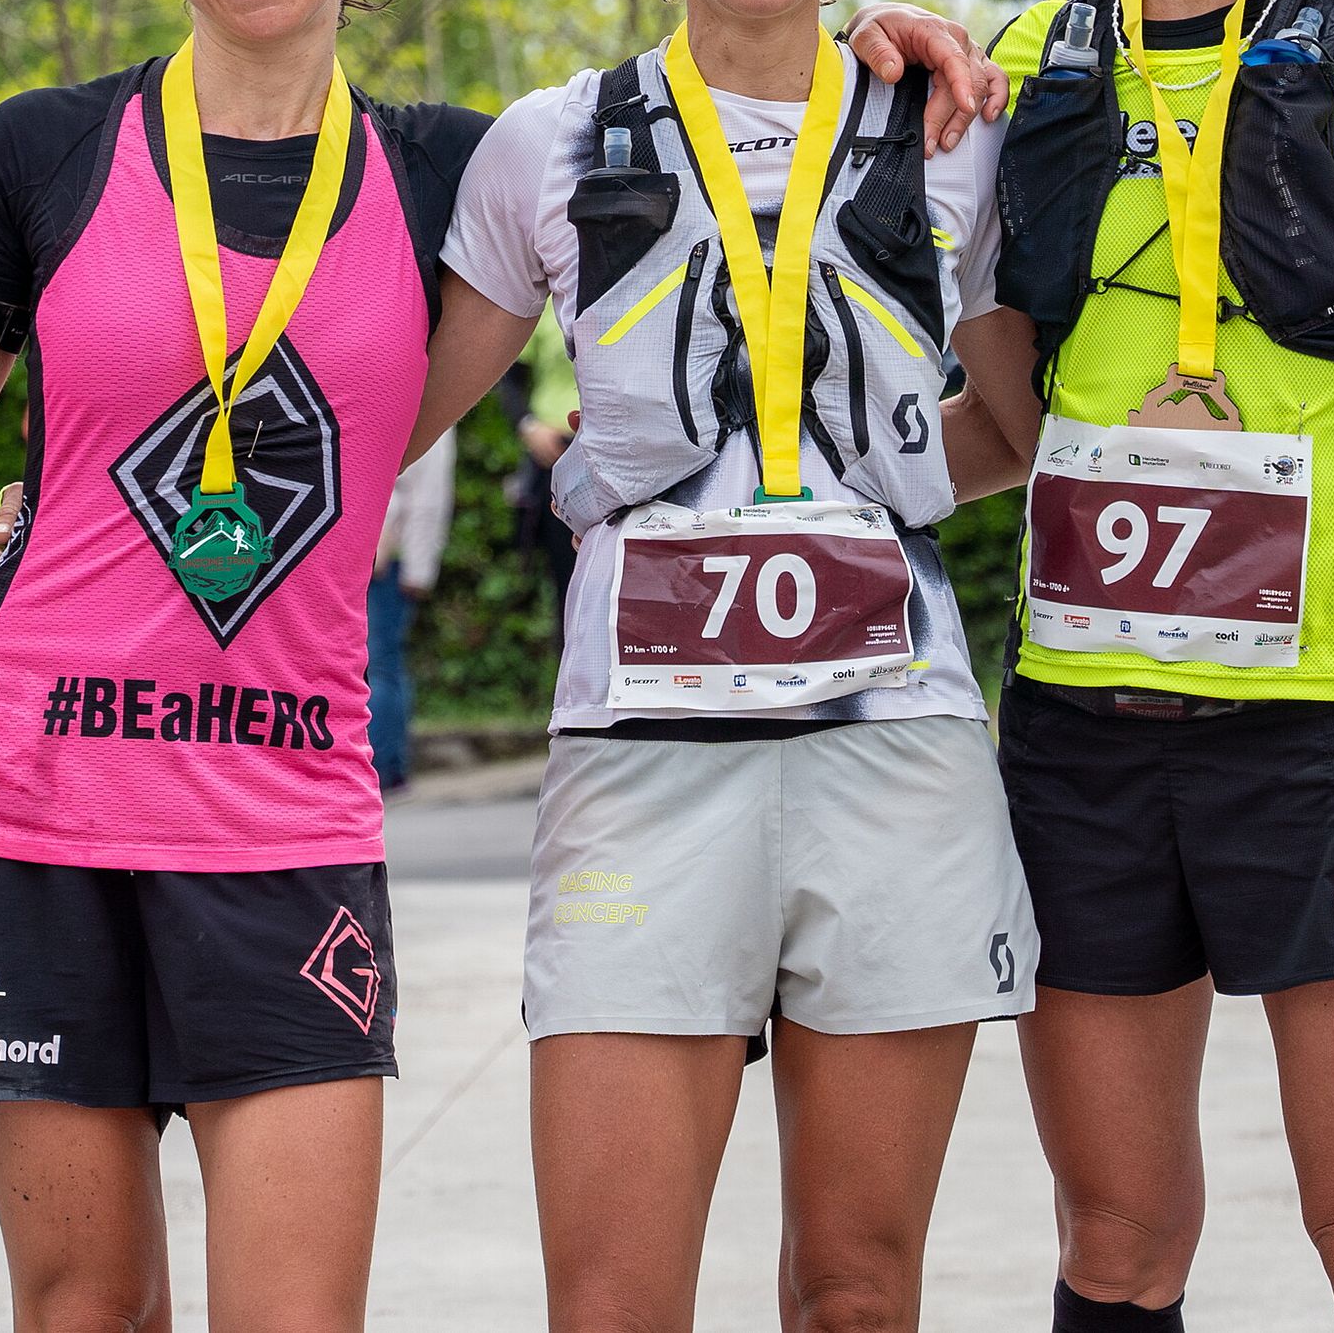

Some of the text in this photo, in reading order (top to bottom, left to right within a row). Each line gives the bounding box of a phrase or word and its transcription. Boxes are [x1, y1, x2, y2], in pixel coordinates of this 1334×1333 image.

[1095, 500, 1213, 589] 97
[701, 553, 817, 639] 70
[1157, 630, 1189, 640] Moreschi
[1215, 629, 1239, 641] corti
[624, 645, 634, 654] 29
[634, 645, 646, 653] km
[650, 645, 668, 654] 1700
[832, 667, 855, 679] corti
[775, 678, 808, 687] Moreschi
[43, 676, 335, 752] #BEaHERO
[557, 870, 634, 895] RACING
[553, 902, 649, 926] CONCEPT
